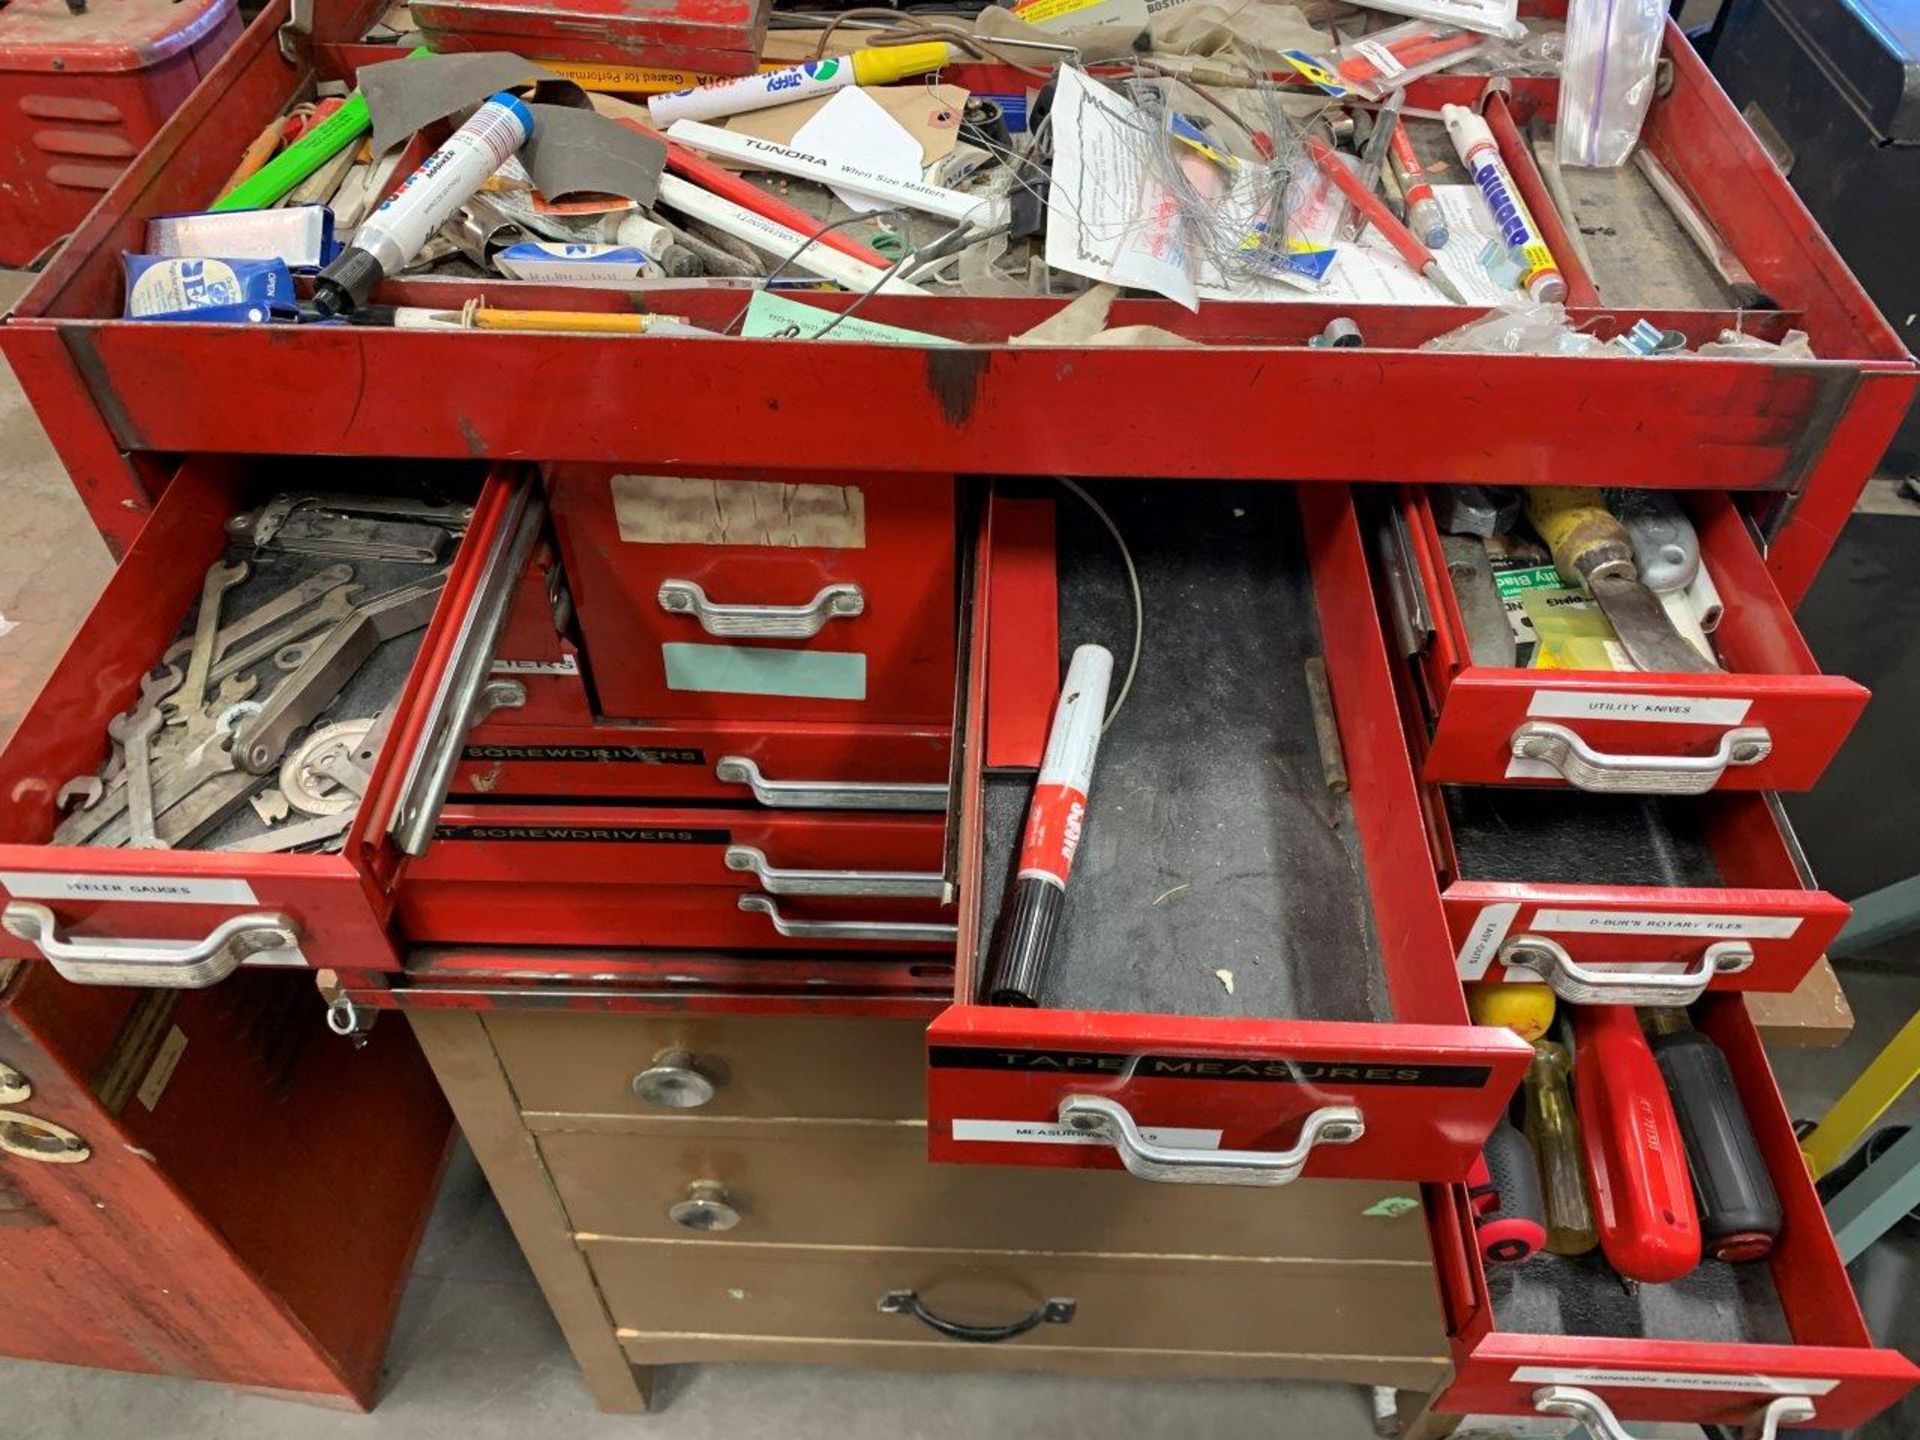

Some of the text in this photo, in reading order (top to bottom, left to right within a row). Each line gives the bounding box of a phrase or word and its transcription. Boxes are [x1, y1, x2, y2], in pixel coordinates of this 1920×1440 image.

[627, 73, 642, 83] for
[647, 75, 684, 85] Geared
[426, 150, 456, 179] MARKER
[745, 138, 828, 167] TUNDRA
[841, 164, 872, 176] When
[874, 173, 900, 187] Size
[267, 272, 276, 297] OPEN
[1588, 703, 1692, 714] UTILITY KNIVES
[469, 749, 696, 760] SCREWDRIVERS
[473, 828, 693, 841] SCREWDRIVERS
[129, 884, 192, 895] GAUGES
[1646, 919, 1701, 929] ROTARY
[1706, 921, 1743, 930] FILES
[1000, 1053, 1421, 1081] TAPE MEASURES
